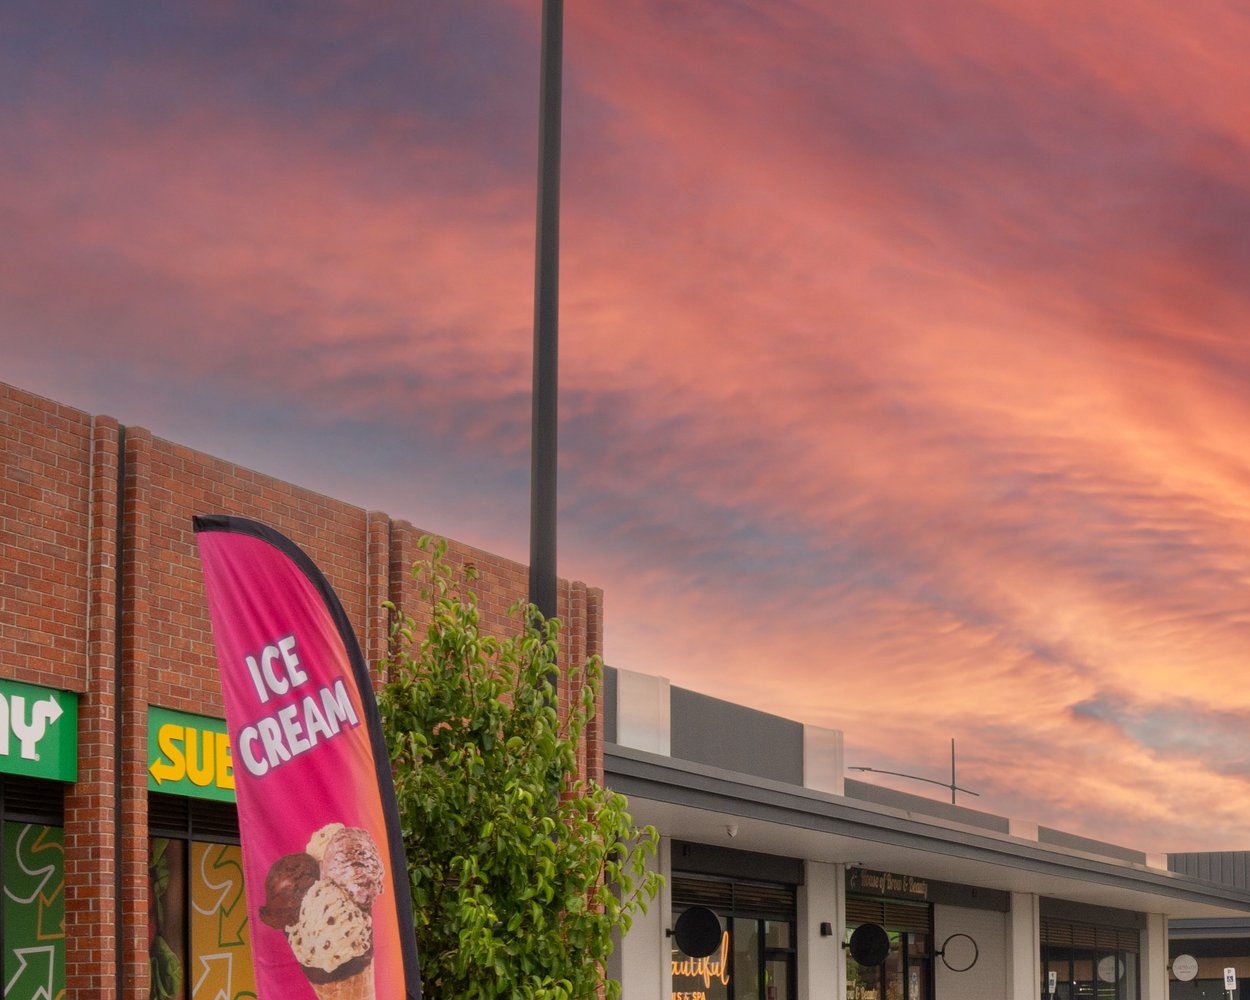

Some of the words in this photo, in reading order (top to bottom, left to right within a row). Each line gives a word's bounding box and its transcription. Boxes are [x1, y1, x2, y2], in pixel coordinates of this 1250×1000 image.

[245, 635, 308, 704] ICE
[239, 679, 360, 777] CREAM
[671, 930, 730, 989] autiful
